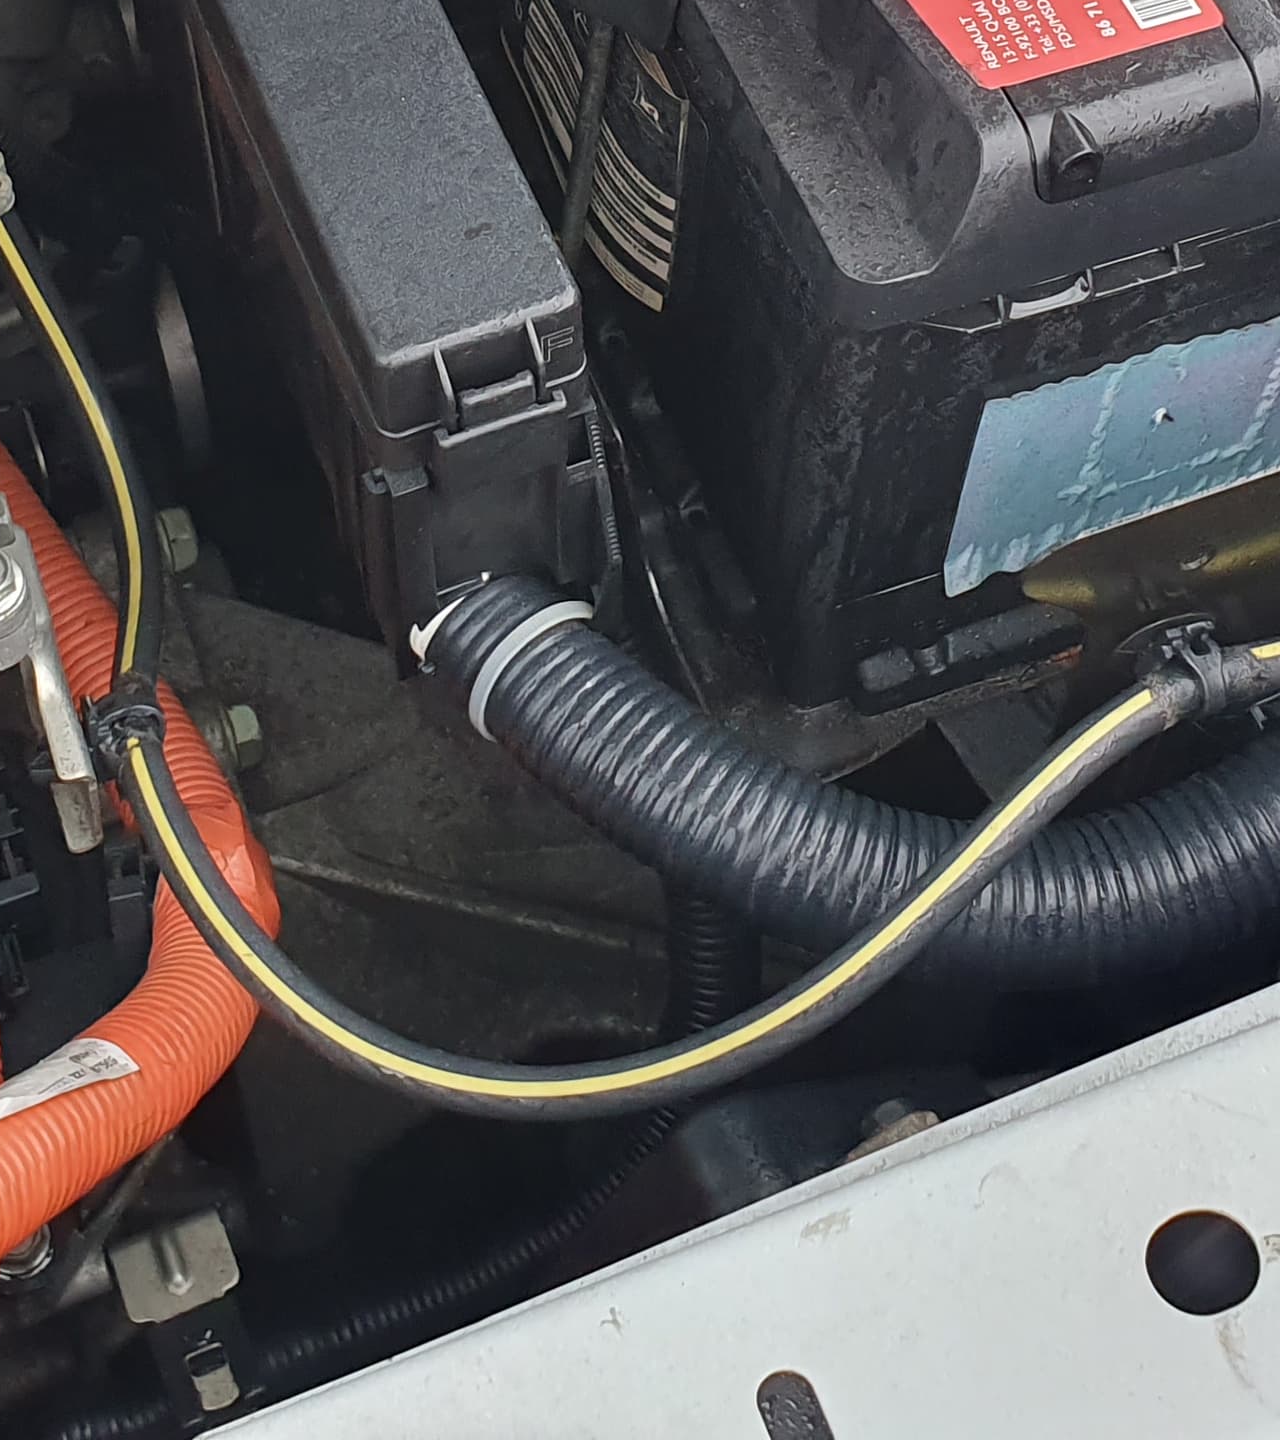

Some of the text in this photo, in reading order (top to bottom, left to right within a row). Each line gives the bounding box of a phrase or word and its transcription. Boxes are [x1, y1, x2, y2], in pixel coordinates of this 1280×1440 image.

[971, 0, 1003, 32] QUAI
[1022, 12, 1047, 34] +33
[1083, 1, 1104, 18] 71
[958, 14, 1002, 69] RENAULT
[1002, 15, 1040, 59] F-92100
[1036, 34, 1059, 53] Tel:
[1095, 19, 1116, 38] 86
[992, 33, 1021, 63] 13-15
[540, 326, 574, 363] F
